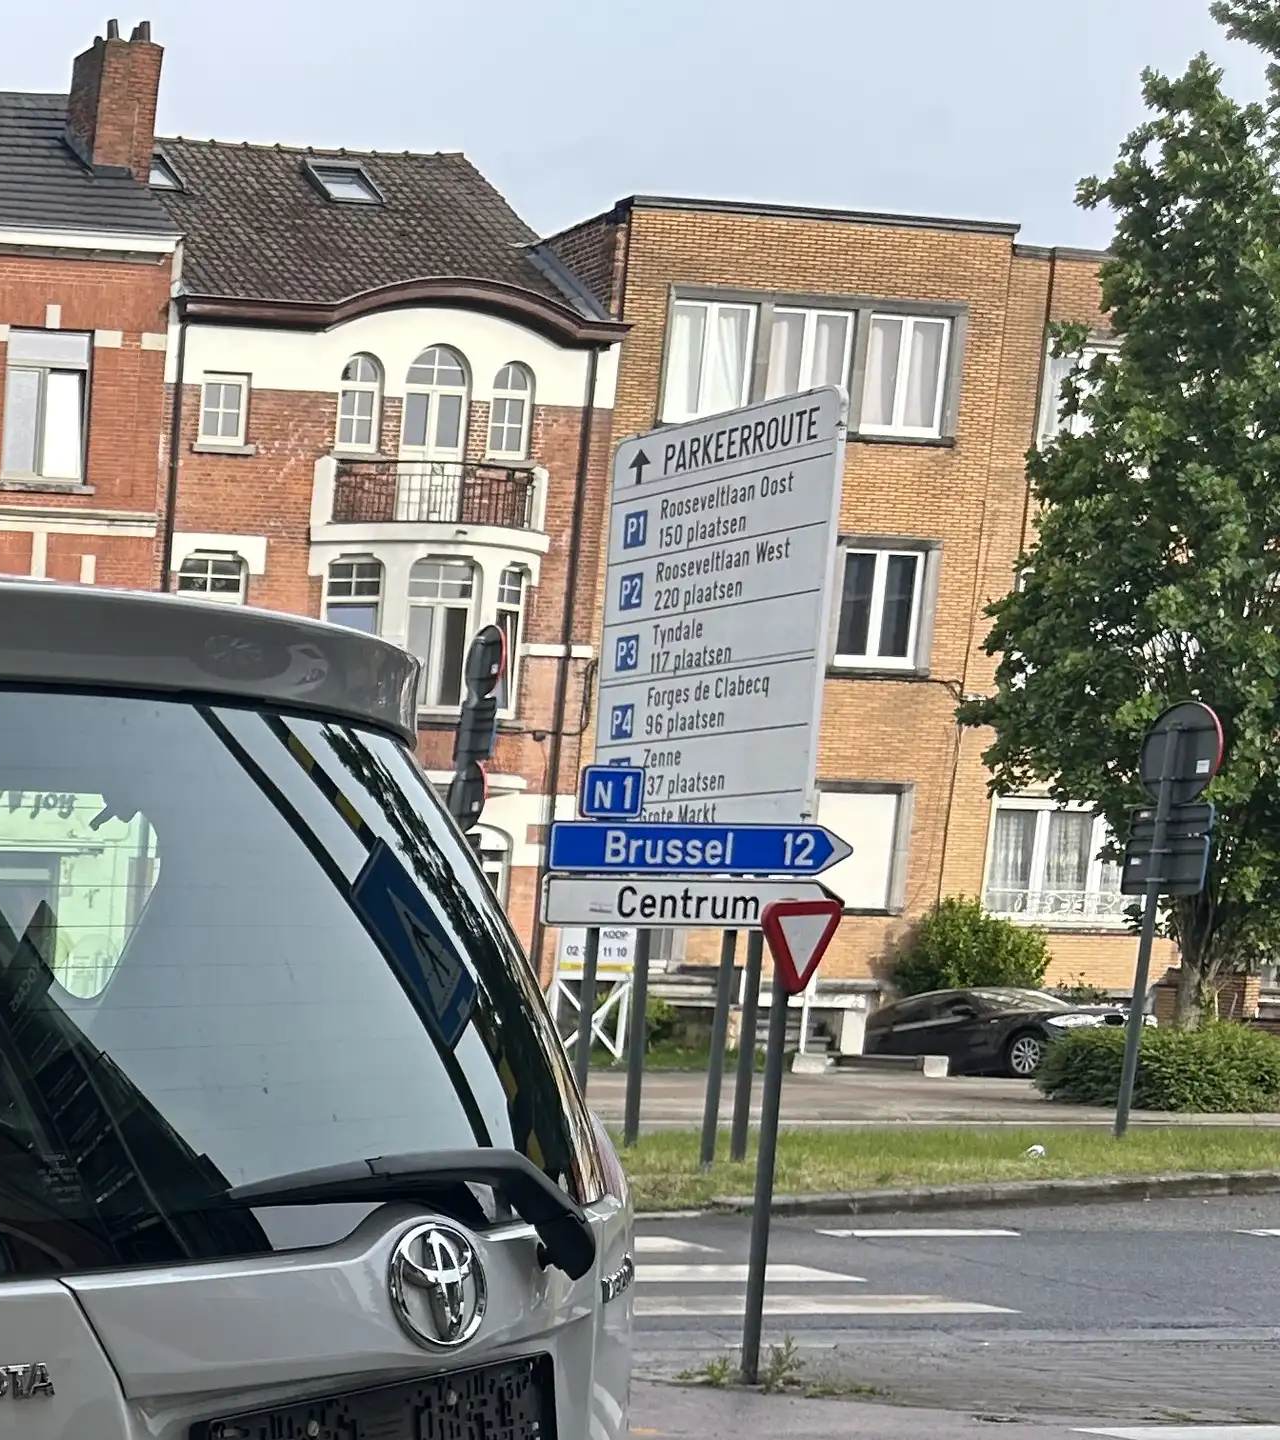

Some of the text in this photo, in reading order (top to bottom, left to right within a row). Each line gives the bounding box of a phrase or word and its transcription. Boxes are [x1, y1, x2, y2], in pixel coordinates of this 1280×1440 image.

[663, 406, 821, 475] PARKEERROUTE
[660, 470, 796, 520] Rooseveltlaan Oost
[626, 515, 646, 545] P1
[658, 514, 747, 550] 150 plaatsen
[655, 538, 791, 583] Rooseveltlaan West
[621, 577, 642, 608] P2
[654, 577, 743, 612] 220 plaatsen
[652, 620, 704, 647] Tyndale
[617, 638, 638, 668] P3
[650, 645, 732, 678] 117 plaatsen
[646, 673, 771, 710] Forges de Clabecq
[613, 709, 633, 737] P4
[644, 709, 725, 741] 96 plaatsen
[643, 748, 682, 769] Zenne
[593, 775, 633, 809] N 1
[646, 771, 725, 800] 37 plaatsen
[678, 802, 717, 823] Markt
[604, 830, 816, 866] Brussel 12
[616, 886, 760, 921] Centrum
